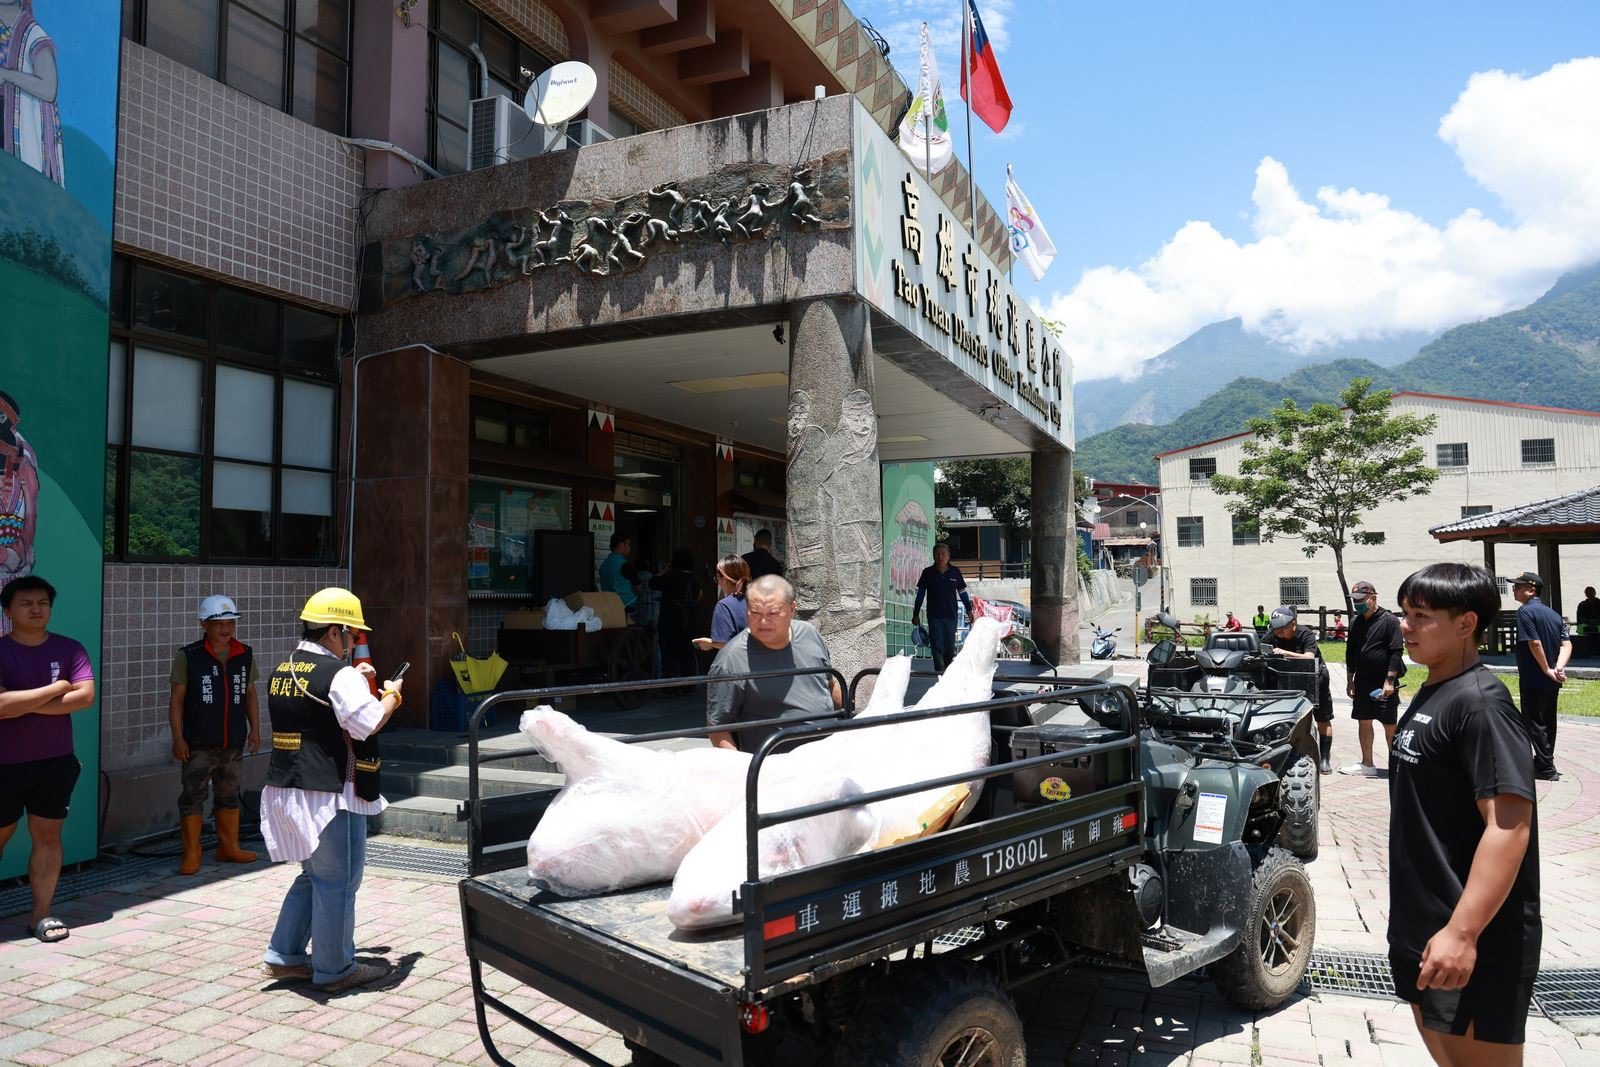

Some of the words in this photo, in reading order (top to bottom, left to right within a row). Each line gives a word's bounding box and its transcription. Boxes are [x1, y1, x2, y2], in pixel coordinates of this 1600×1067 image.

[900, 172, 1062, 400] 高雄市桃源區公所
[892, 258, 918, 308] Tao
[919, 283, 950, 335] Yuan
[952, 313, 989, 368] District
[992, 349, 1015, 388] Office
[1017, 371, 1049, 421] Kaohsiung
[1050, 395, 1062, 430] City
[201, 675, 213, 704] 高紀明
[270, 677, 309, 698] 原民會
[982, 844, 1048, 877] TJ800L
[798, 860, 970, 933] 農地搬運車
